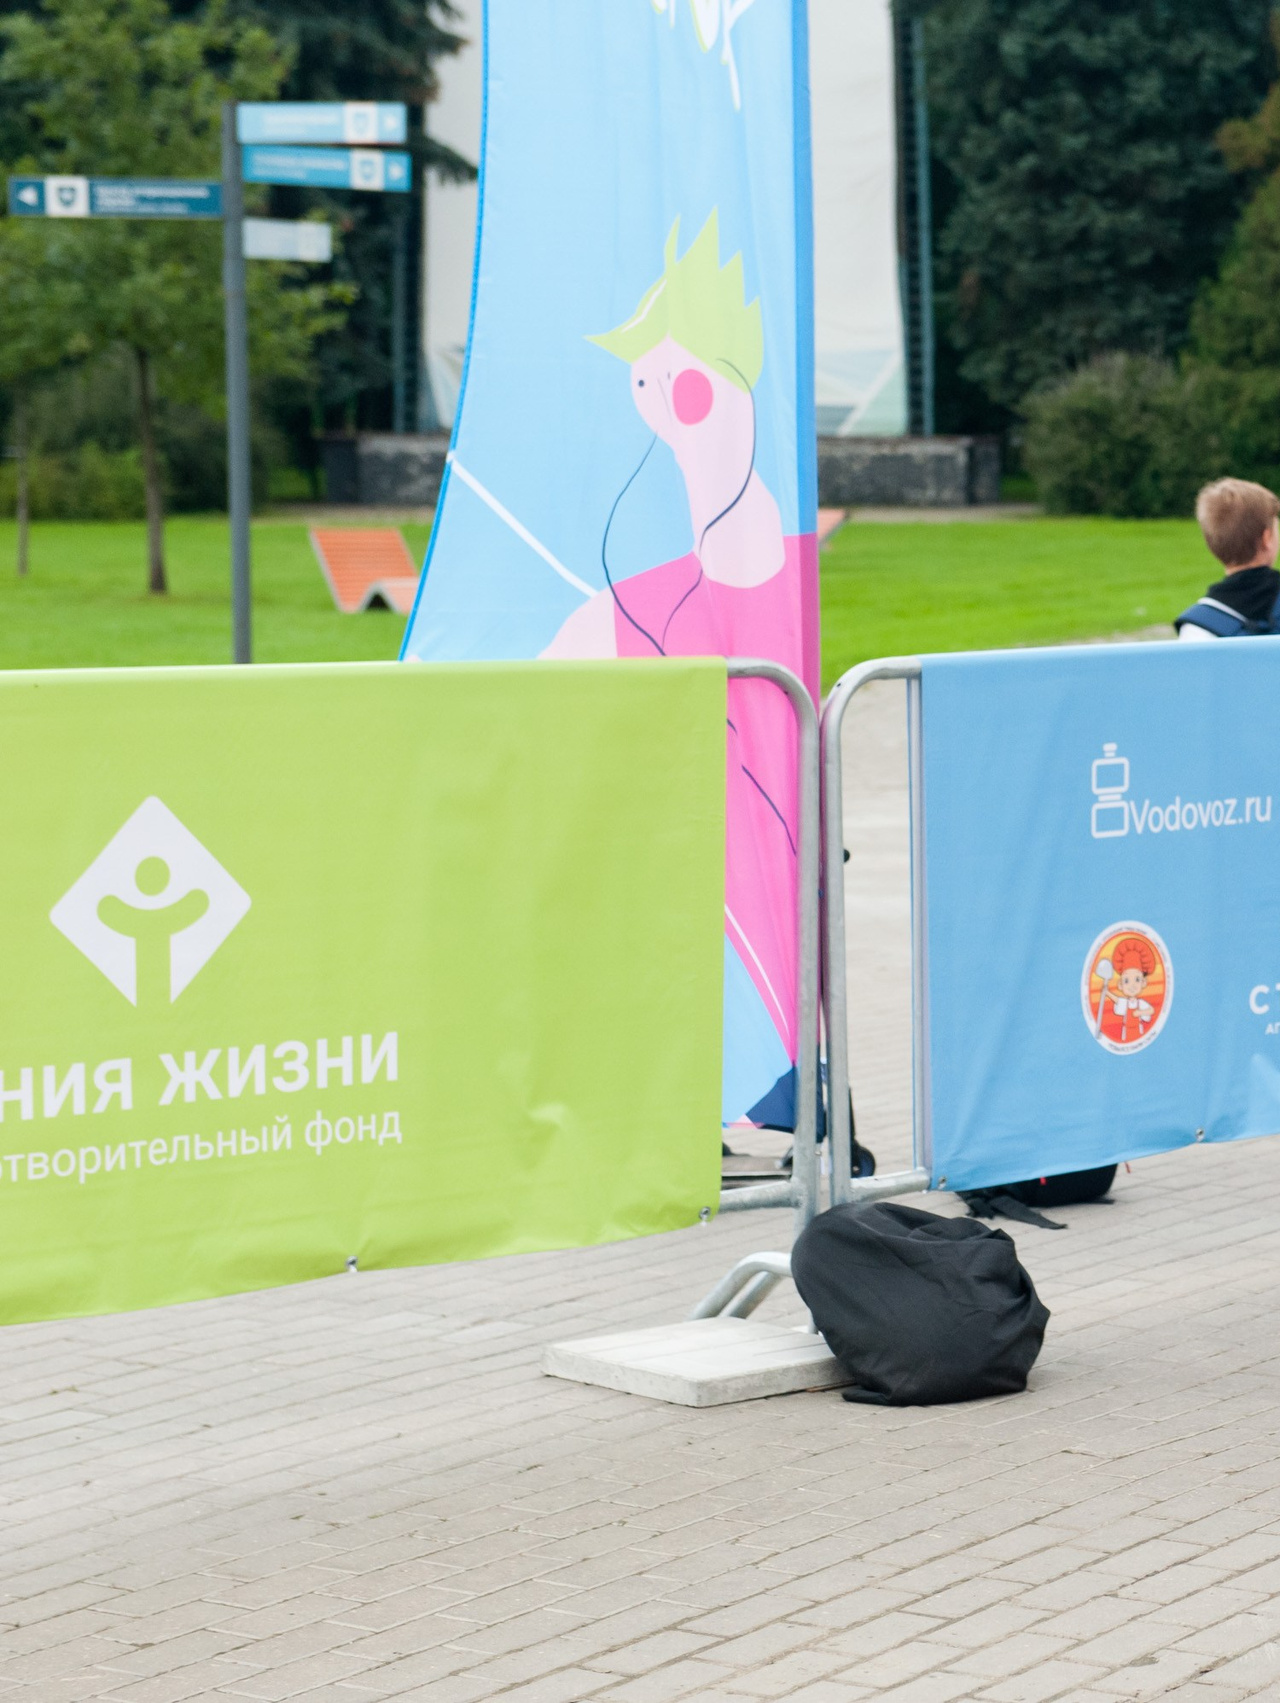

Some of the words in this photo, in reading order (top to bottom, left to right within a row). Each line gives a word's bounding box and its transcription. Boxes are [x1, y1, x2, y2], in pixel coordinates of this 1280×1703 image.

[1130, 796, 1272, 834] Vodovoz.ru
[0, 1057, 133, 1124] НИЯ
[158, 1031, 399, 1107] ЖИЗНИ
[0, 1114, 292, 1185] творительный
[304, 1109, 403, 1156] фонд
